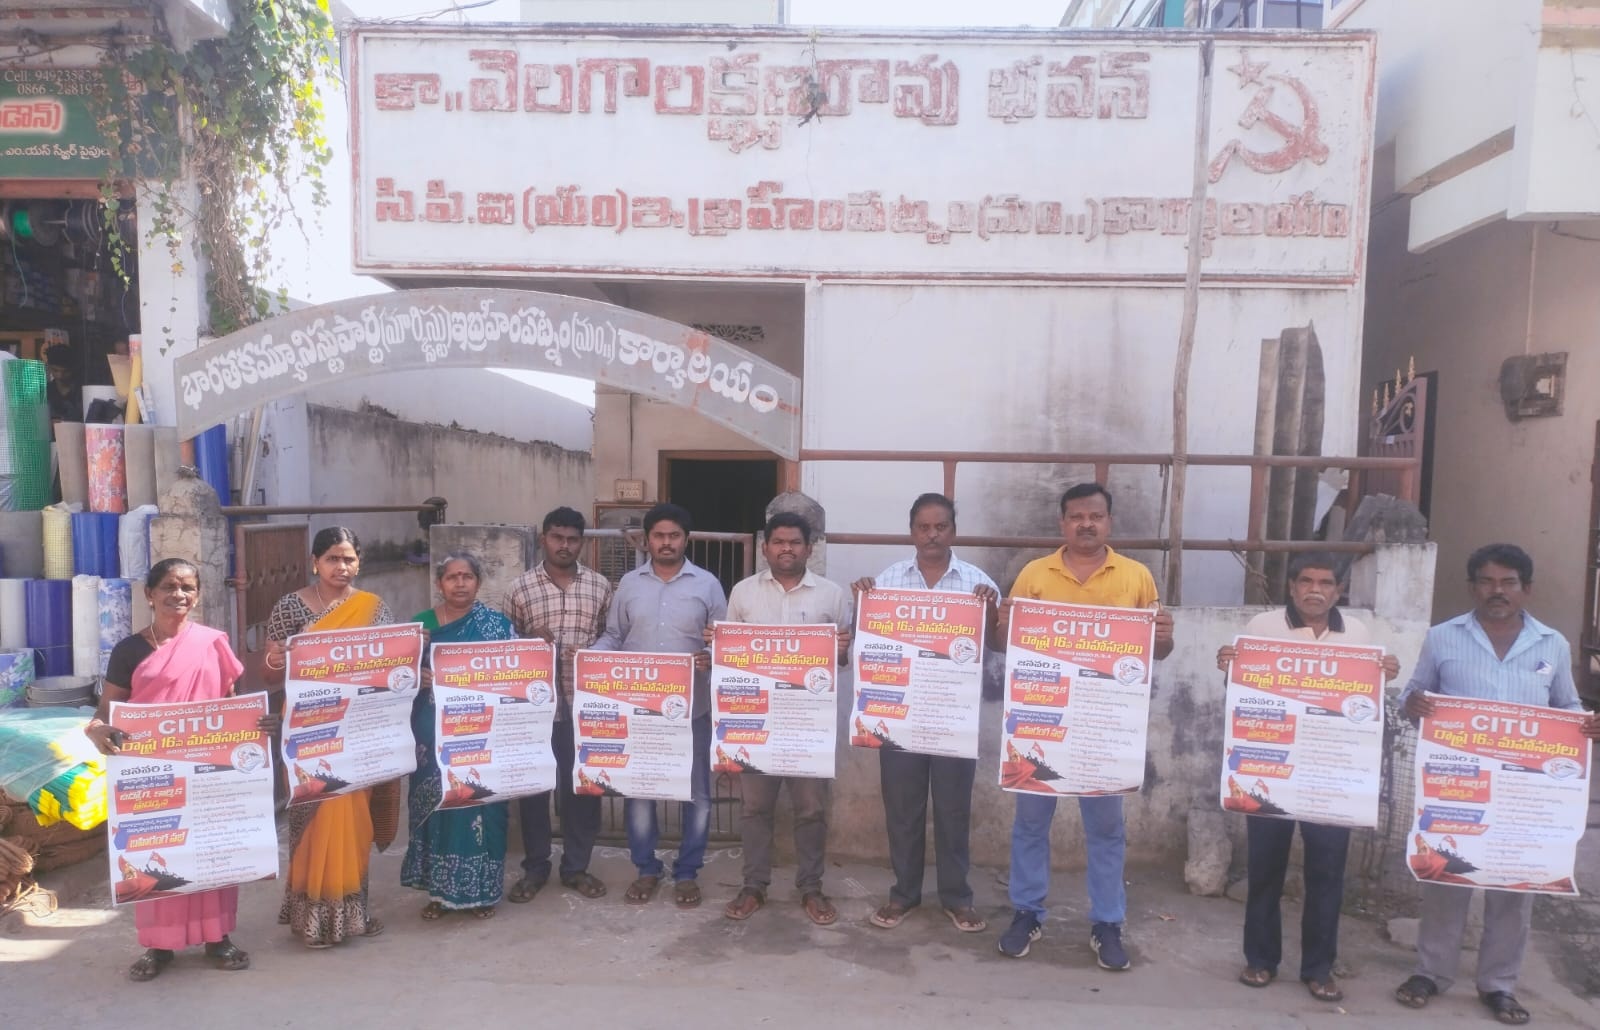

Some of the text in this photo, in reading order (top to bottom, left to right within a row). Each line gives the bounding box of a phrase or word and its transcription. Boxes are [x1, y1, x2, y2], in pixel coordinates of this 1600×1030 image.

[17, 83, 47, 95] 0866
[987, 51, 1150, 123] భవన్
[895, 605, 946, 620] CITU
[1053, 620, 1111, 638] CITU
[329, 642, 384, 661] CITU
[750, 638, 801, 652] CITU
[1075, 639, 1143, 655] మహాసభలు
[470, 655, 520, 670] CITU
[1276, 657, 1338, 676] CITU
[611, 666, 659, 680] CITU
[159, 715, 224, 735] CITU
[1471, 714, 1540, 737] CITU
[186, 729, 260, 746] మహాసభలు
